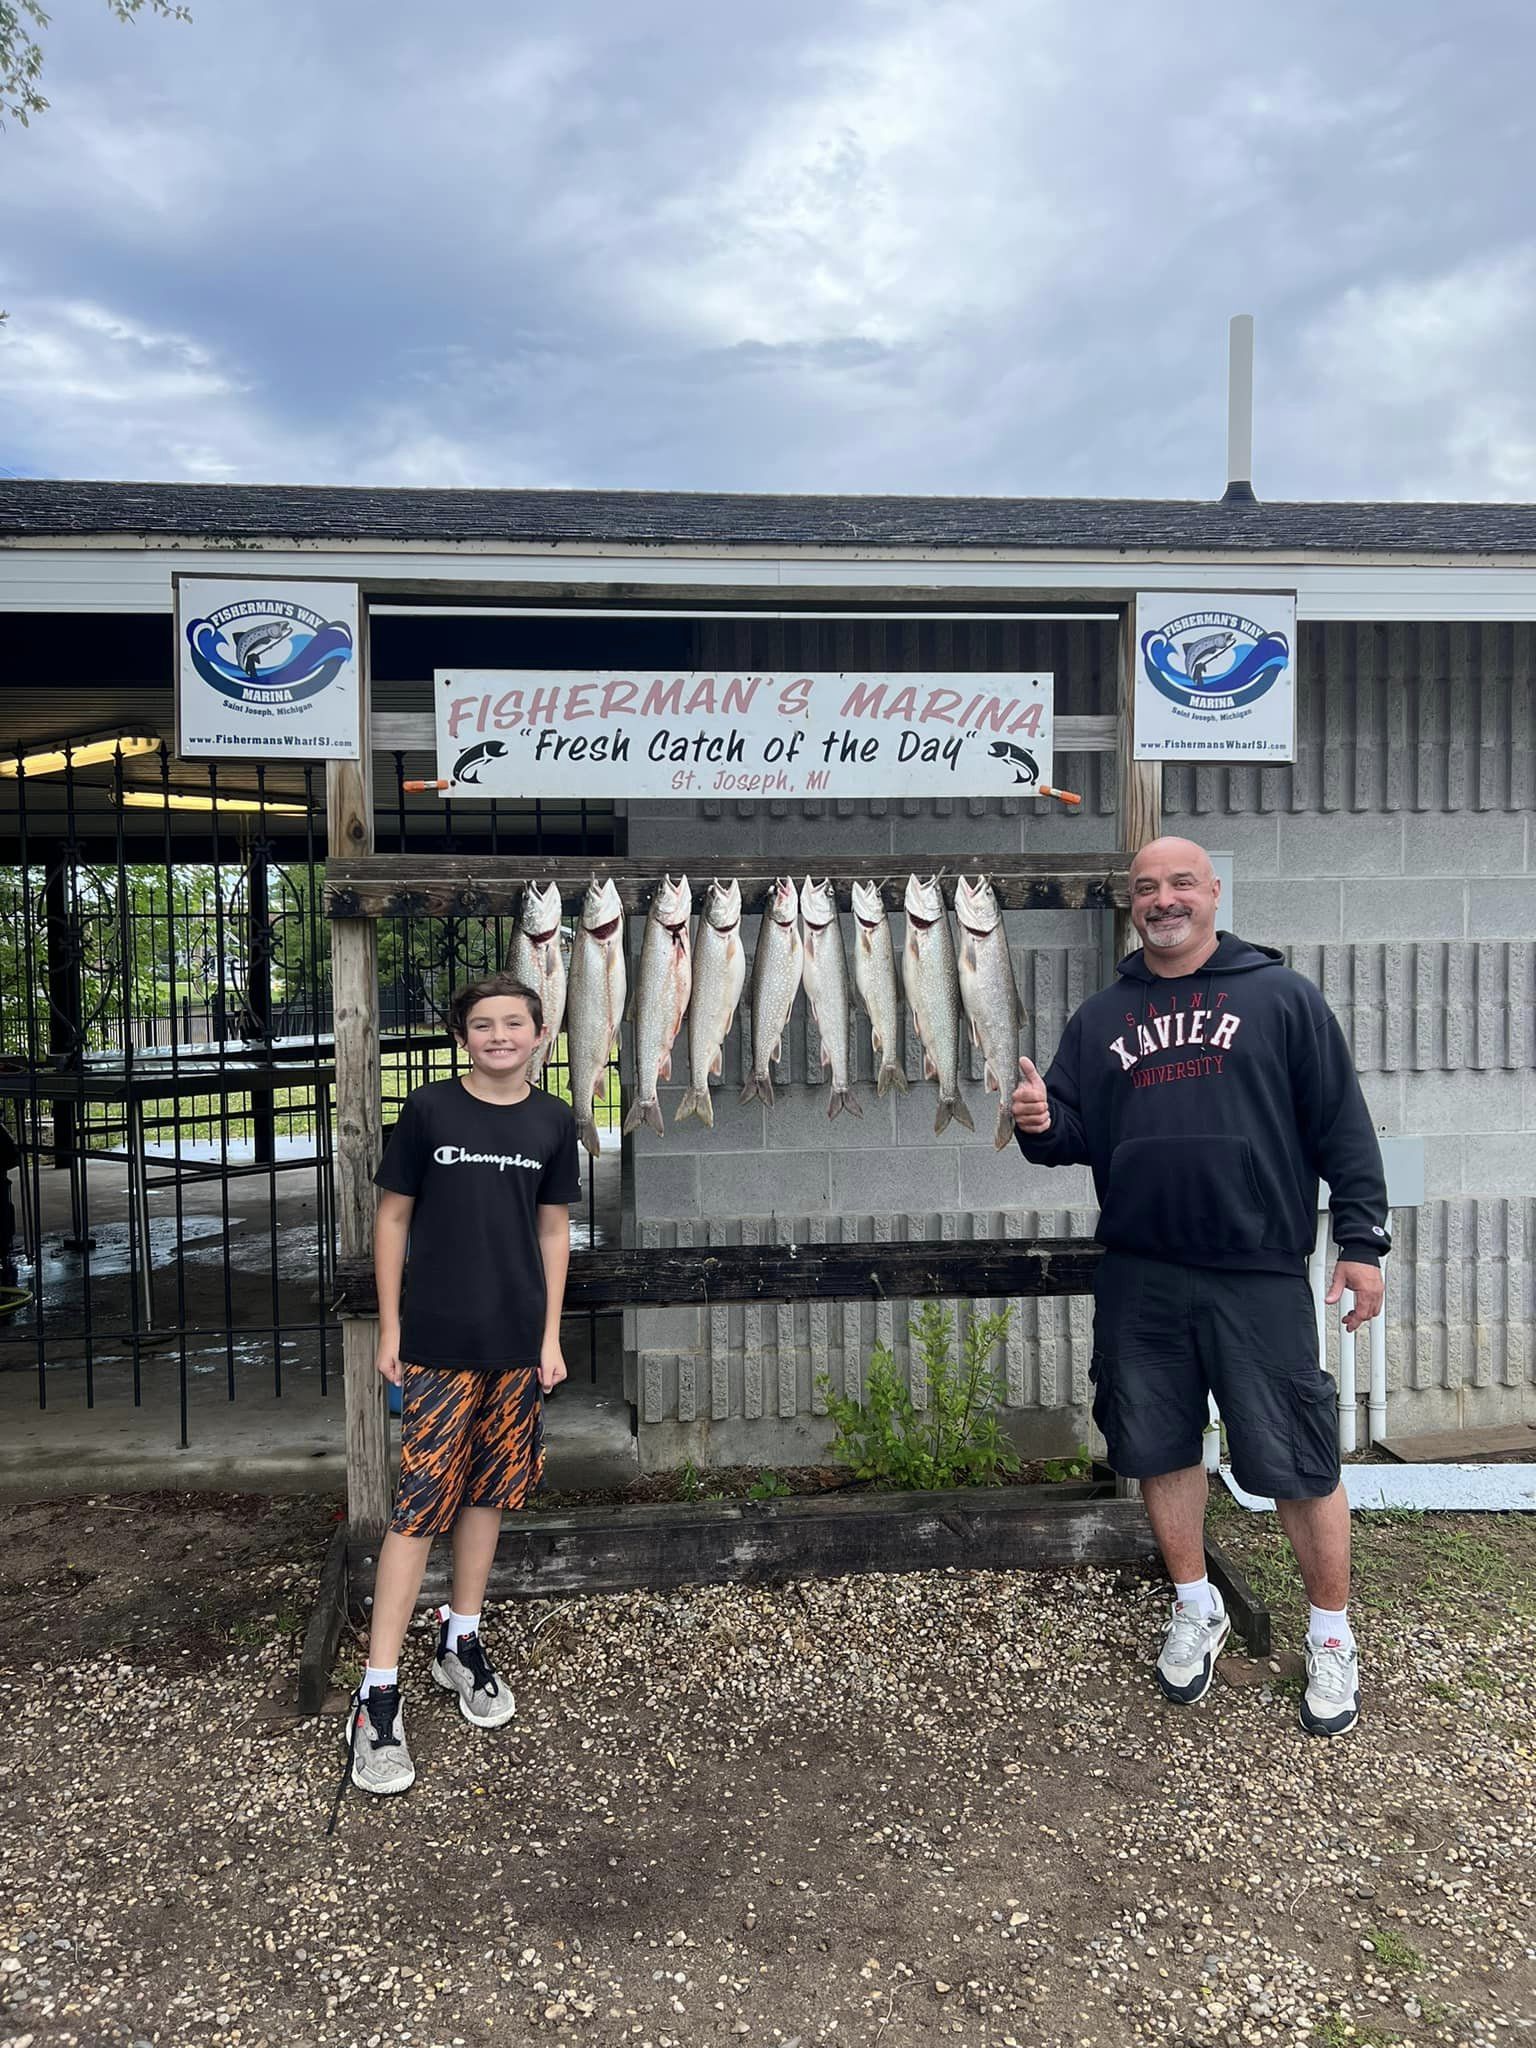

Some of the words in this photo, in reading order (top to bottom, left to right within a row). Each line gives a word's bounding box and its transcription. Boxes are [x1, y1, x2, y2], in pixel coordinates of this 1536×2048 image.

[210, 601, 294, 627] FISHERMAN'S
[297, 608, 323, 629] WAY
[1163, 614, 1238, 638] FISHERMAN'S
[1239, 620, 1264, 639] WAY
[242, 689, 293, 701] MARINA
[448, 678, 814, 737] FISHERMAN'S
[840, 682, 1044, 737] MARINA
[1189, 696, 1235, 709] MARINA
[222, 699, 243, 713] Saint
[245, 706, 275, 717] Joseph,
[277, 702, 313, 716] Michigan
[189, 734, 352, 747] www.FishermansWharfSJ.com
[649, 729, 745, 762] Catch
[763, 730, 805, 763] of
[821, 729, 879, 762] the
[1140, 739, 1287, 750] www.FishermansWharfSJ.com
[671, 769, 702, 790] St.
[713, 769, 794, 794] Joseph,
[805, 769, 831, 790] MI
[1124, 992, 1228, 1027] SAINT
[1109, 1010, 1241, 1071] XAVIER
[1133, 1055, 1224, 1088] UNIVERSITY
[433, 1145, 543, 1171] Champion
